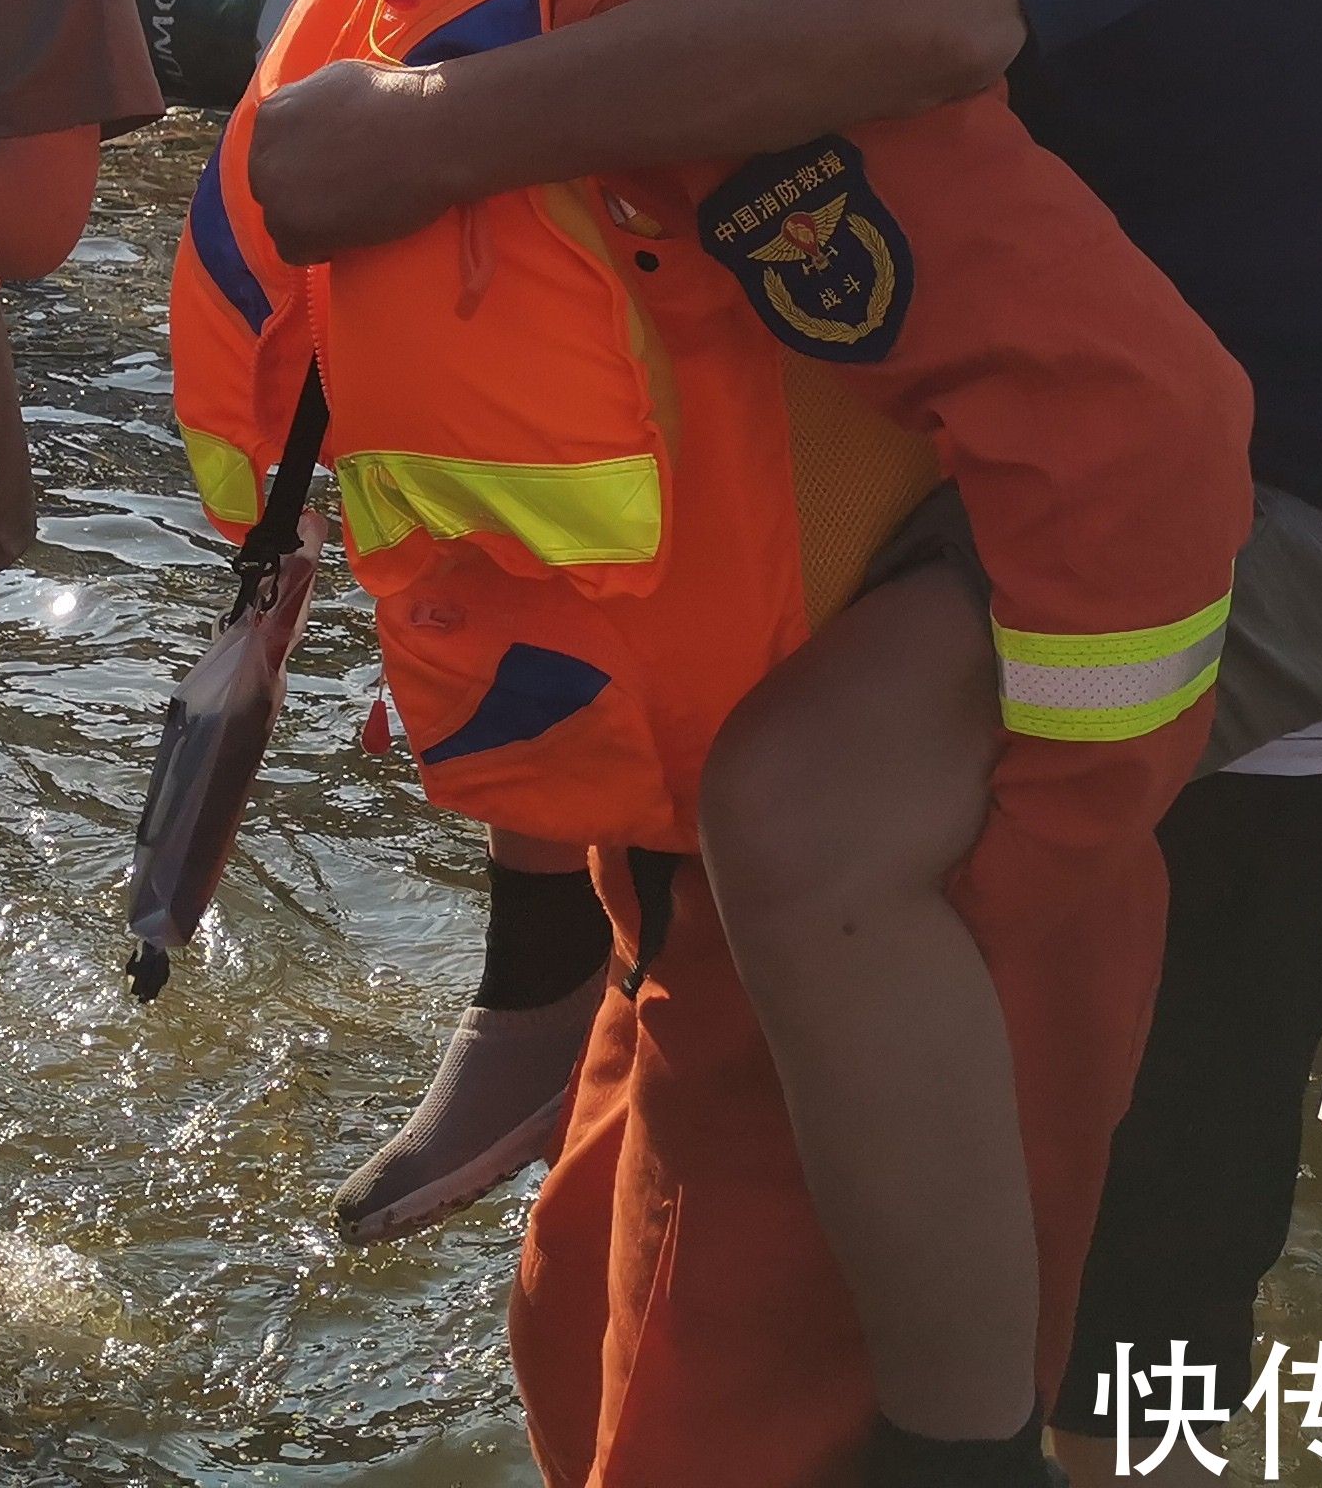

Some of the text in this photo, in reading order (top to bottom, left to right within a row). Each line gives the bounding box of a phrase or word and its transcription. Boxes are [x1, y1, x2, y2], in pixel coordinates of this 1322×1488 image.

[714, 149, 846, 244] 中国消防救援
[818, 274, 862, 310] 战斗
